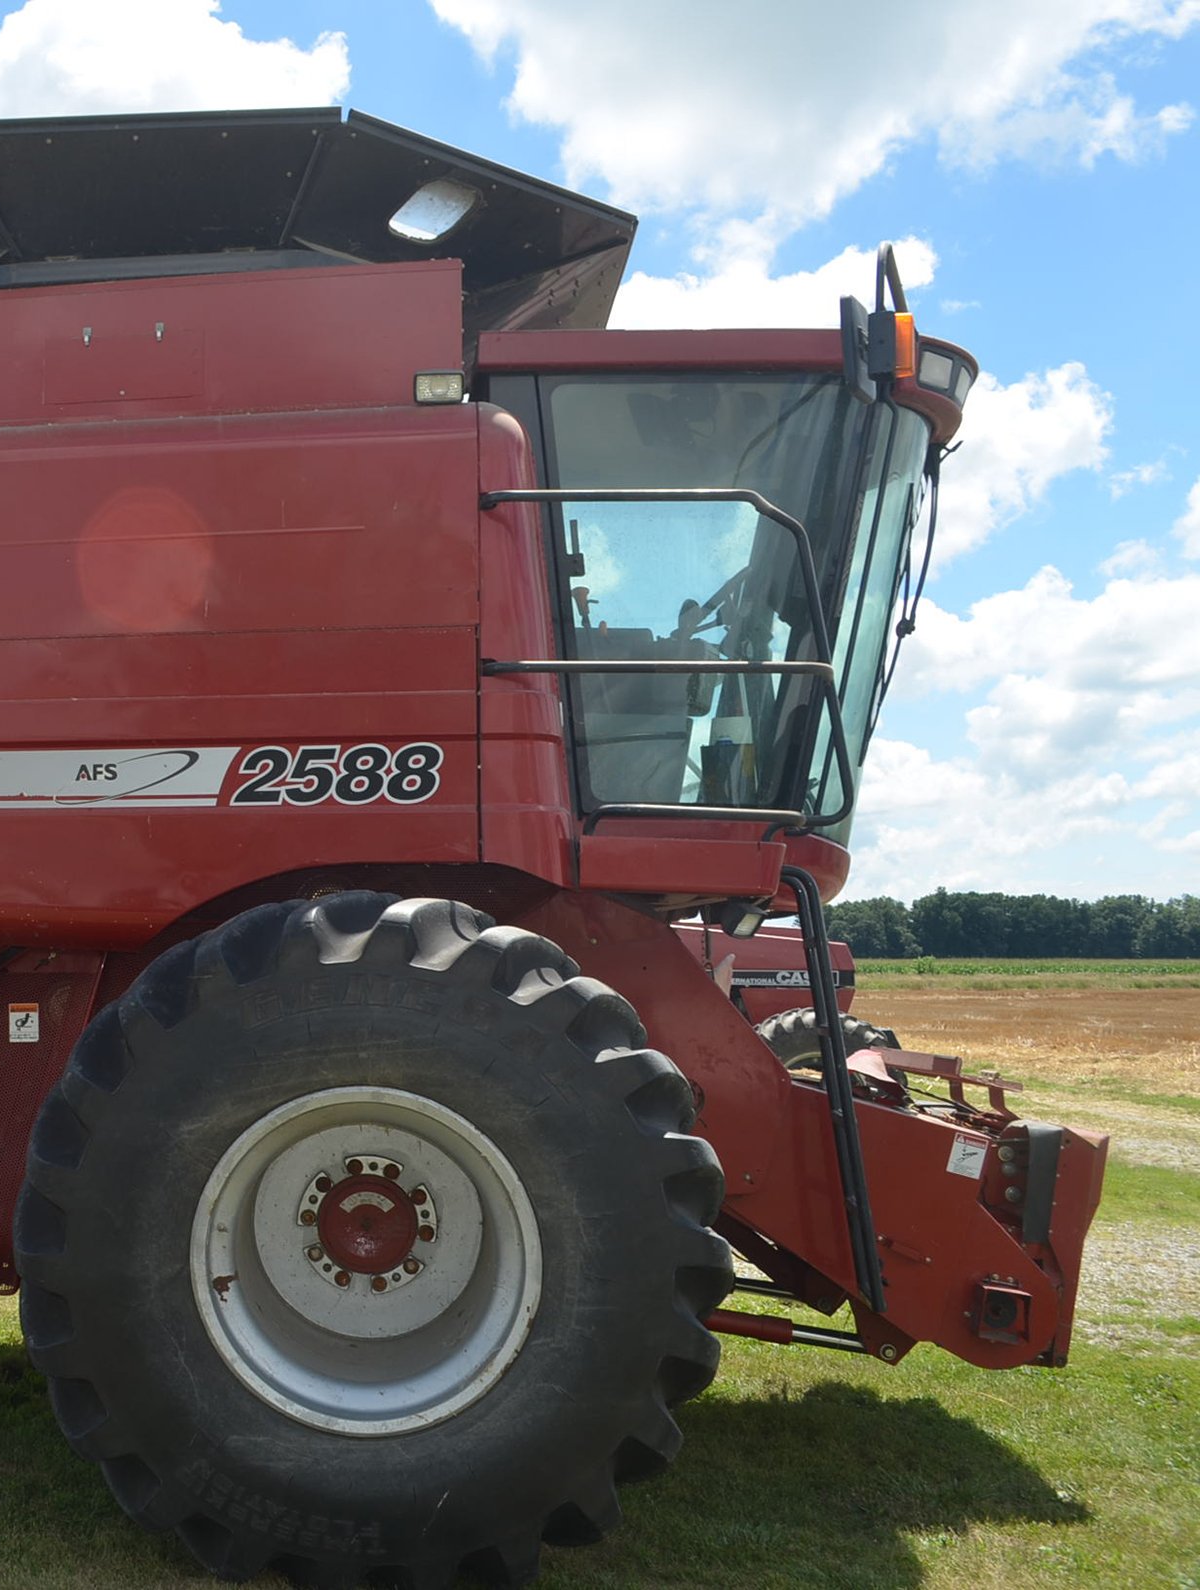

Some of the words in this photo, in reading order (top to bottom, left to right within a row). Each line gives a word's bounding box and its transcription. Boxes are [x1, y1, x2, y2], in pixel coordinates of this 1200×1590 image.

[75, 763, 118, 781] AFS
[230, 742, 444, 807] 2588
[731, 977, 776, 985] ERNATIONAL
